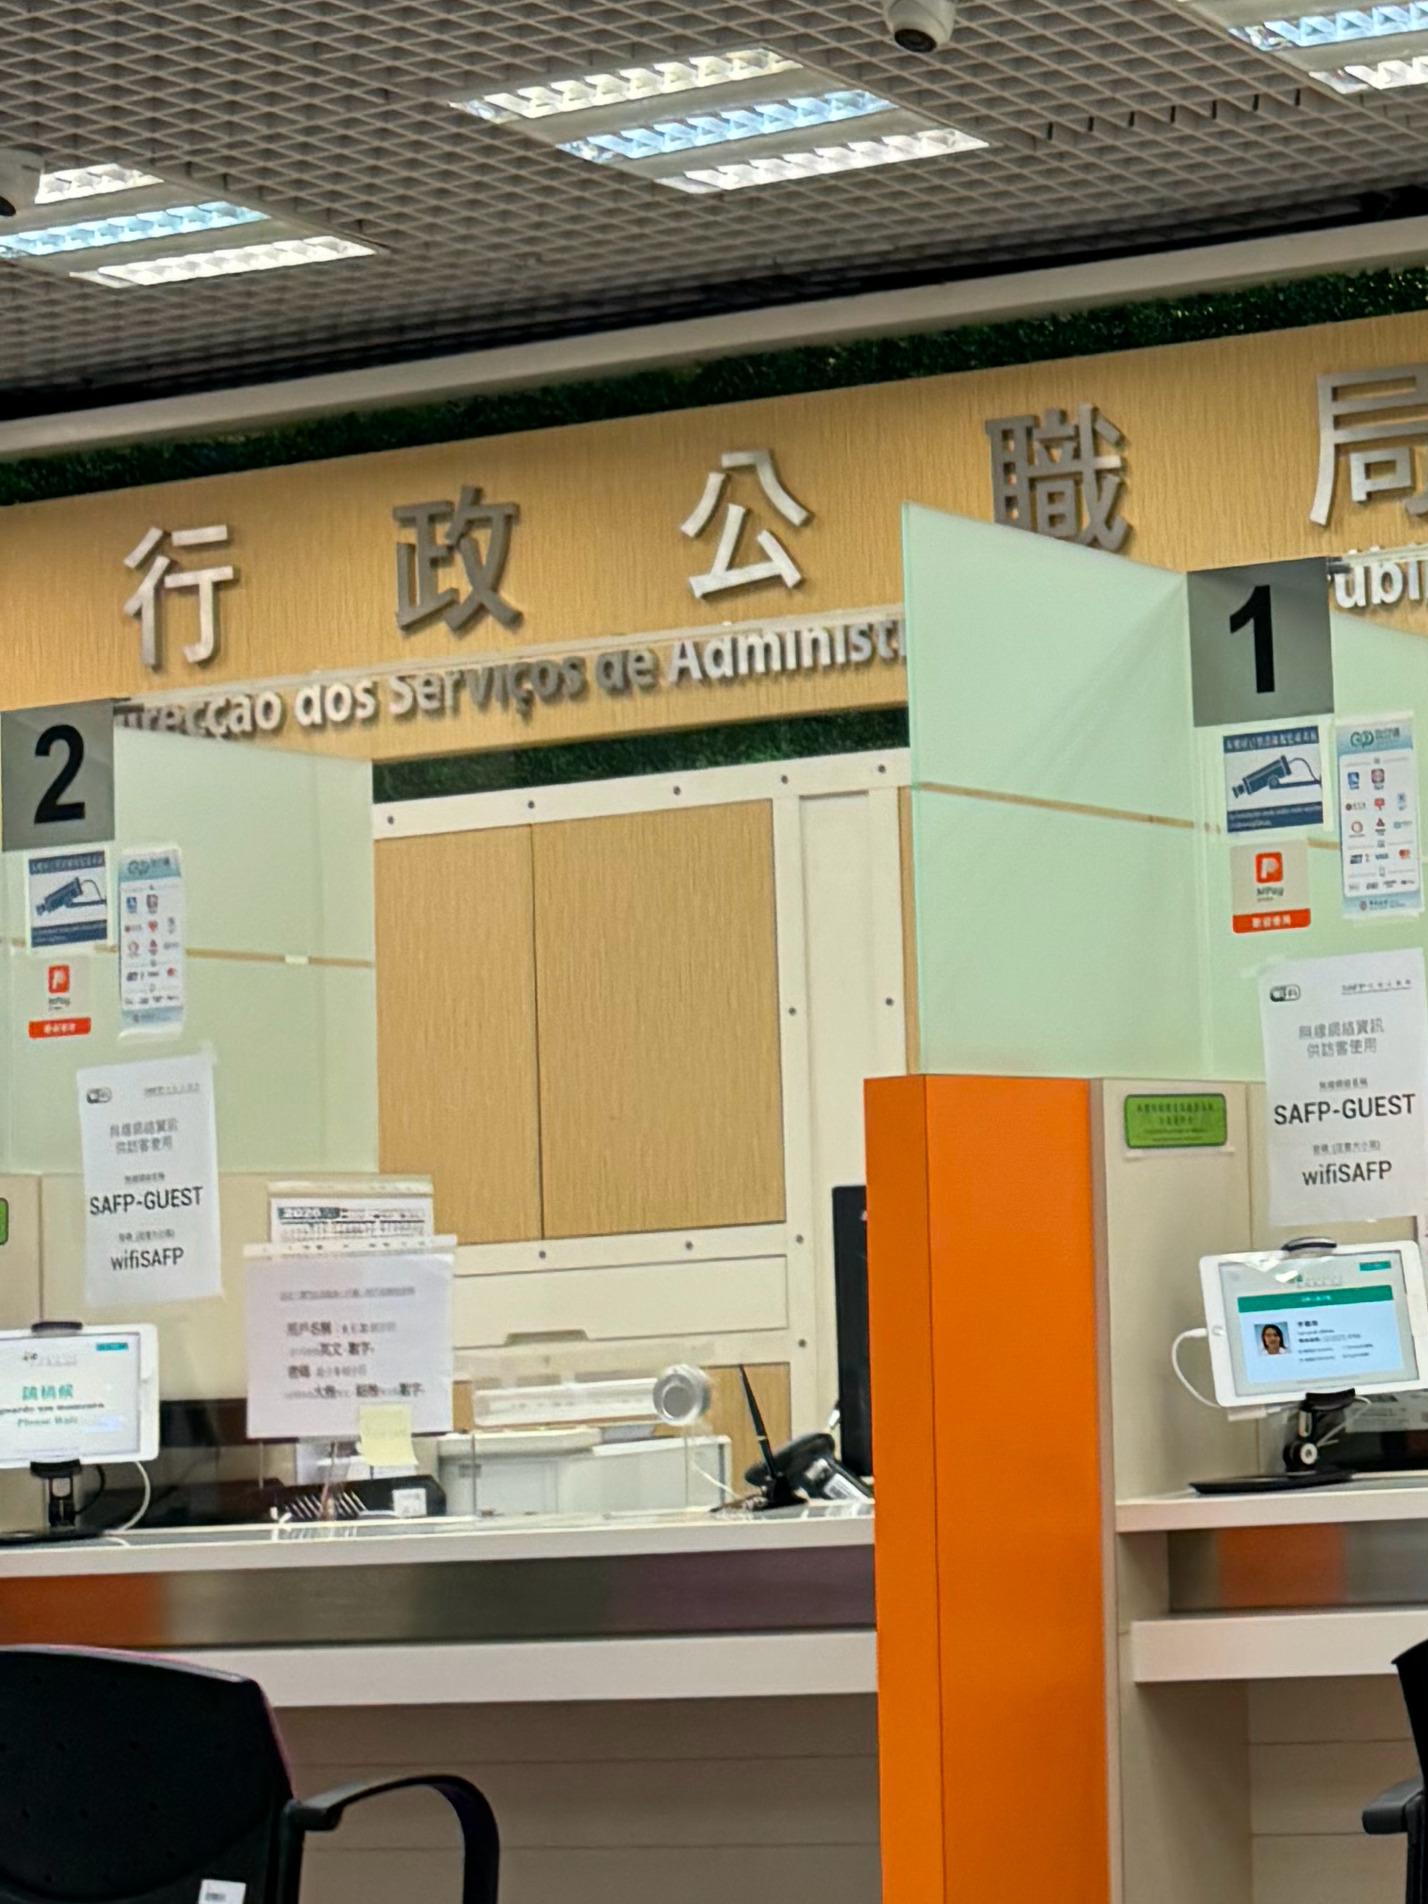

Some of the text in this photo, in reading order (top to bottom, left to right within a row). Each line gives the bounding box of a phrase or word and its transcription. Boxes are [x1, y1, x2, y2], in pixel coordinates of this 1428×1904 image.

[1229, 584, 1275, 694] 1
[294, 680, 377, 727] dos
[389, 649, 583, 718] Serviços
[596, 647, 657, 691] de
[33, 725, 87, 825] 2
[1274, 1094, 1416, 1126] SAFP-GUEST
[1302, 1160, 1393, 1186] wifiSAFP
[90, 1186, 204, 1216] SAFP-GUEST
[110, 1247, 185, 1271] wifiSAFP
